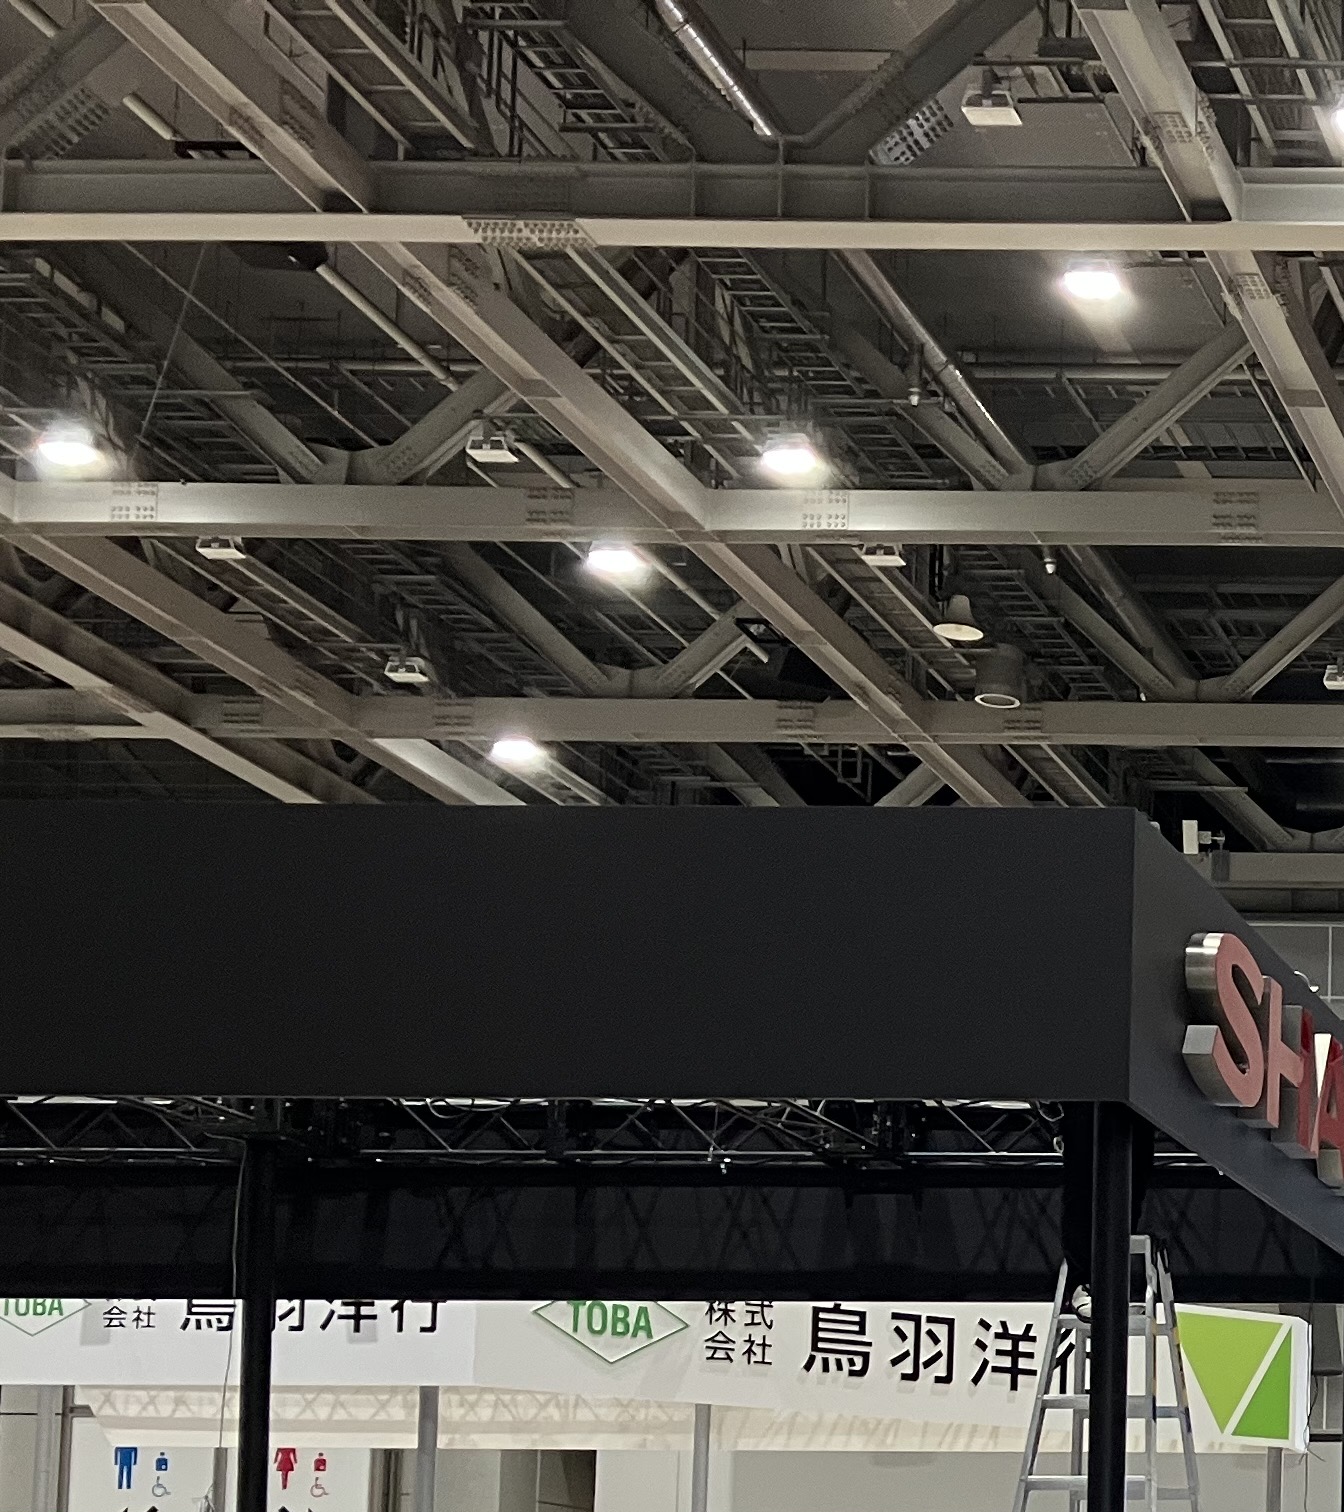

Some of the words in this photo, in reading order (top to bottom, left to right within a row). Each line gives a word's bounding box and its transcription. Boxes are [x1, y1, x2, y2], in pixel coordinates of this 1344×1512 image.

[103, 1305, 156, 1329] 会社
[567, 1300, 654, 1340] TOBA
[704, 1330, 773, 1366] 会社
